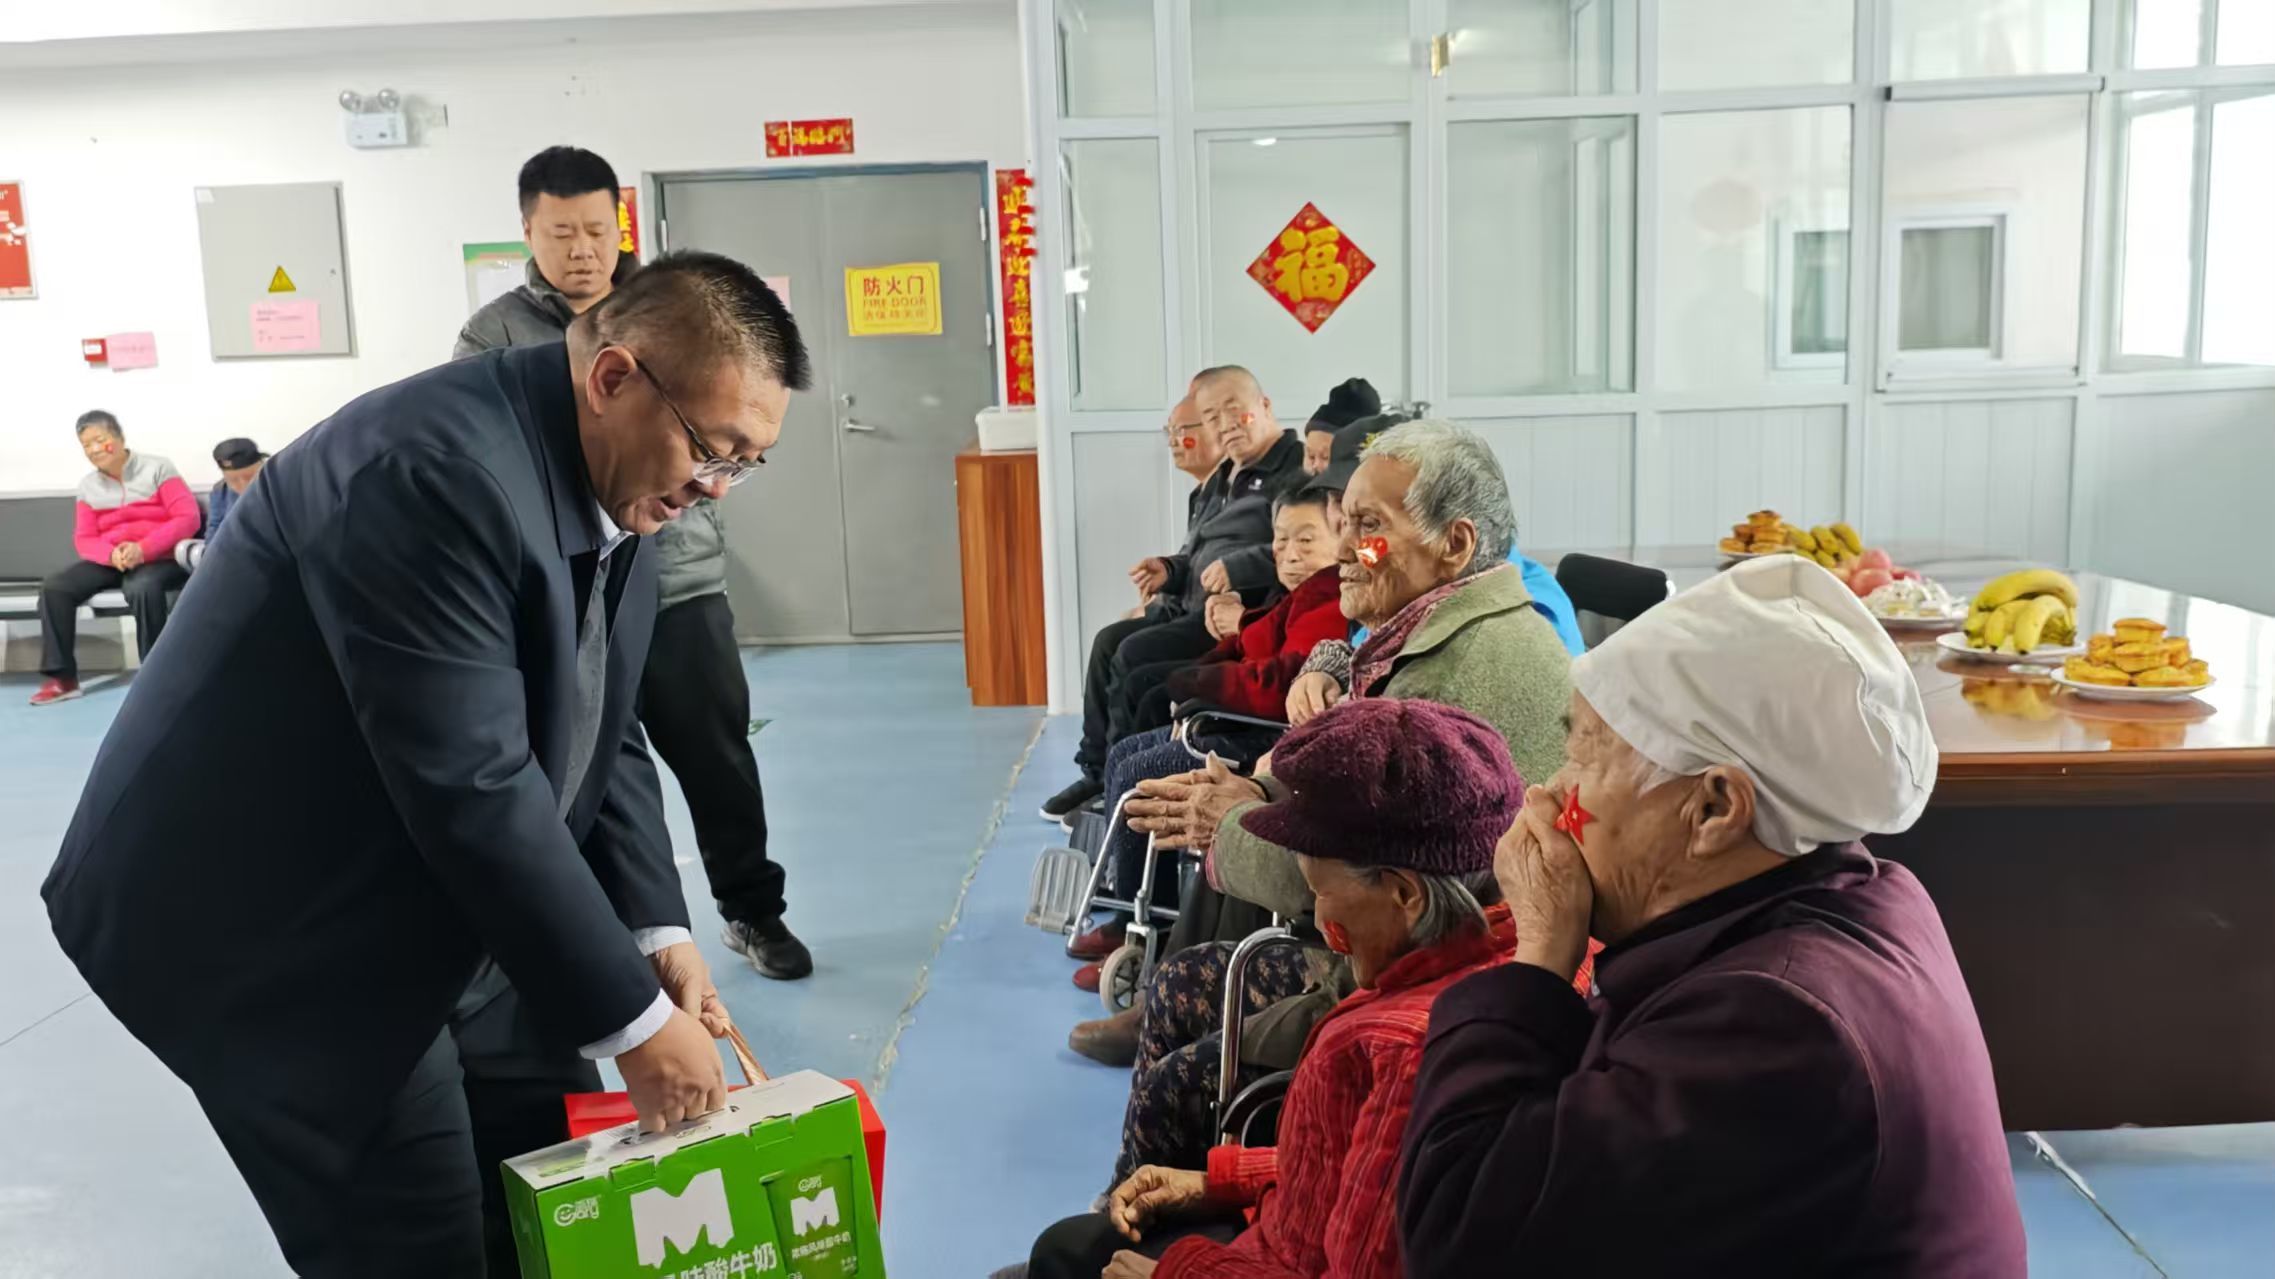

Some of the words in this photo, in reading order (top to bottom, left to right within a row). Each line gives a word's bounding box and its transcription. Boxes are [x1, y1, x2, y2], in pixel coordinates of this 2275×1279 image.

[1274, 226, 1349, 302] 福
[863, 275, 924, 296] 防火门
[863, 298, 887, 308] FIRE
[891, 296, 926, 307] DOOR
